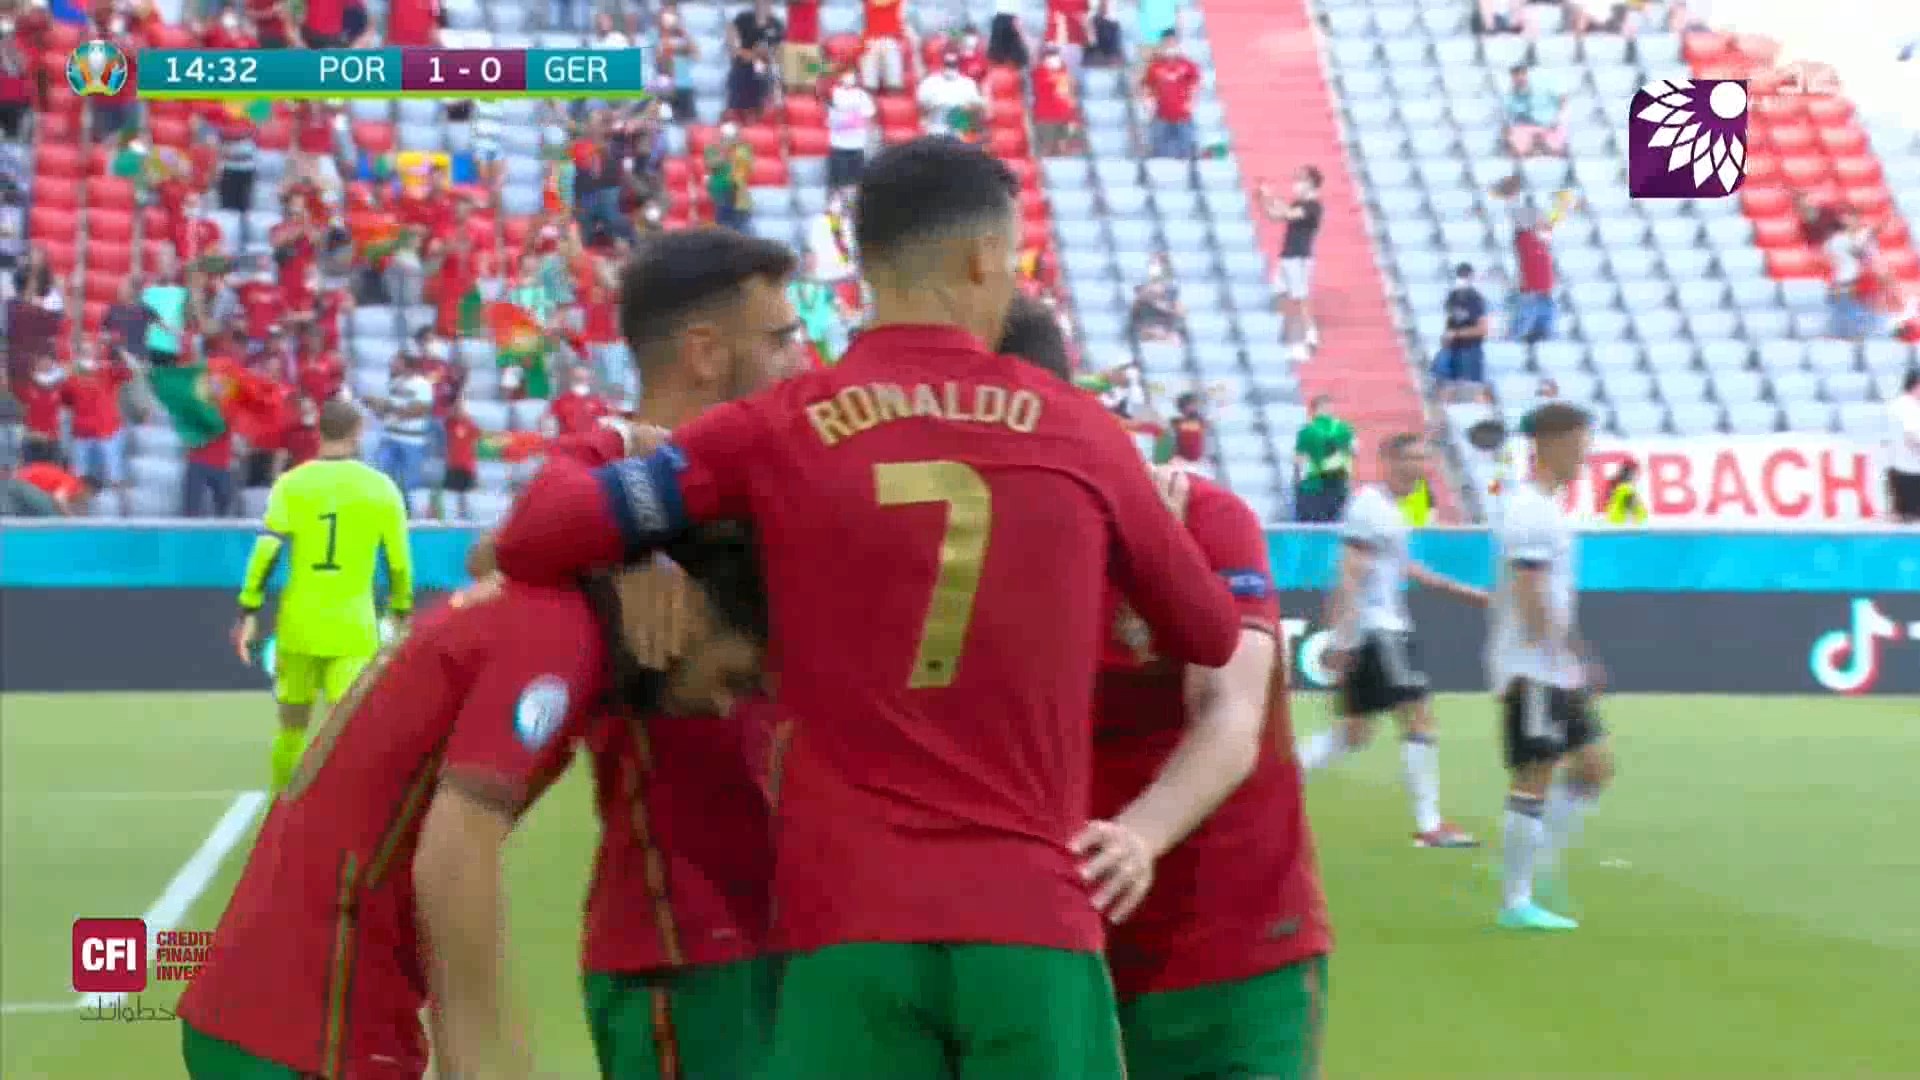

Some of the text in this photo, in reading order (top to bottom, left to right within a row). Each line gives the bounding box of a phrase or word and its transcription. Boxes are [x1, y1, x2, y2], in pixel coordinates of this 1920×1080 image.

[806, 381, 1041, 445] RONALDO
[311, 512, 341, 572] 1
[872, 460, 992, 690] 7
